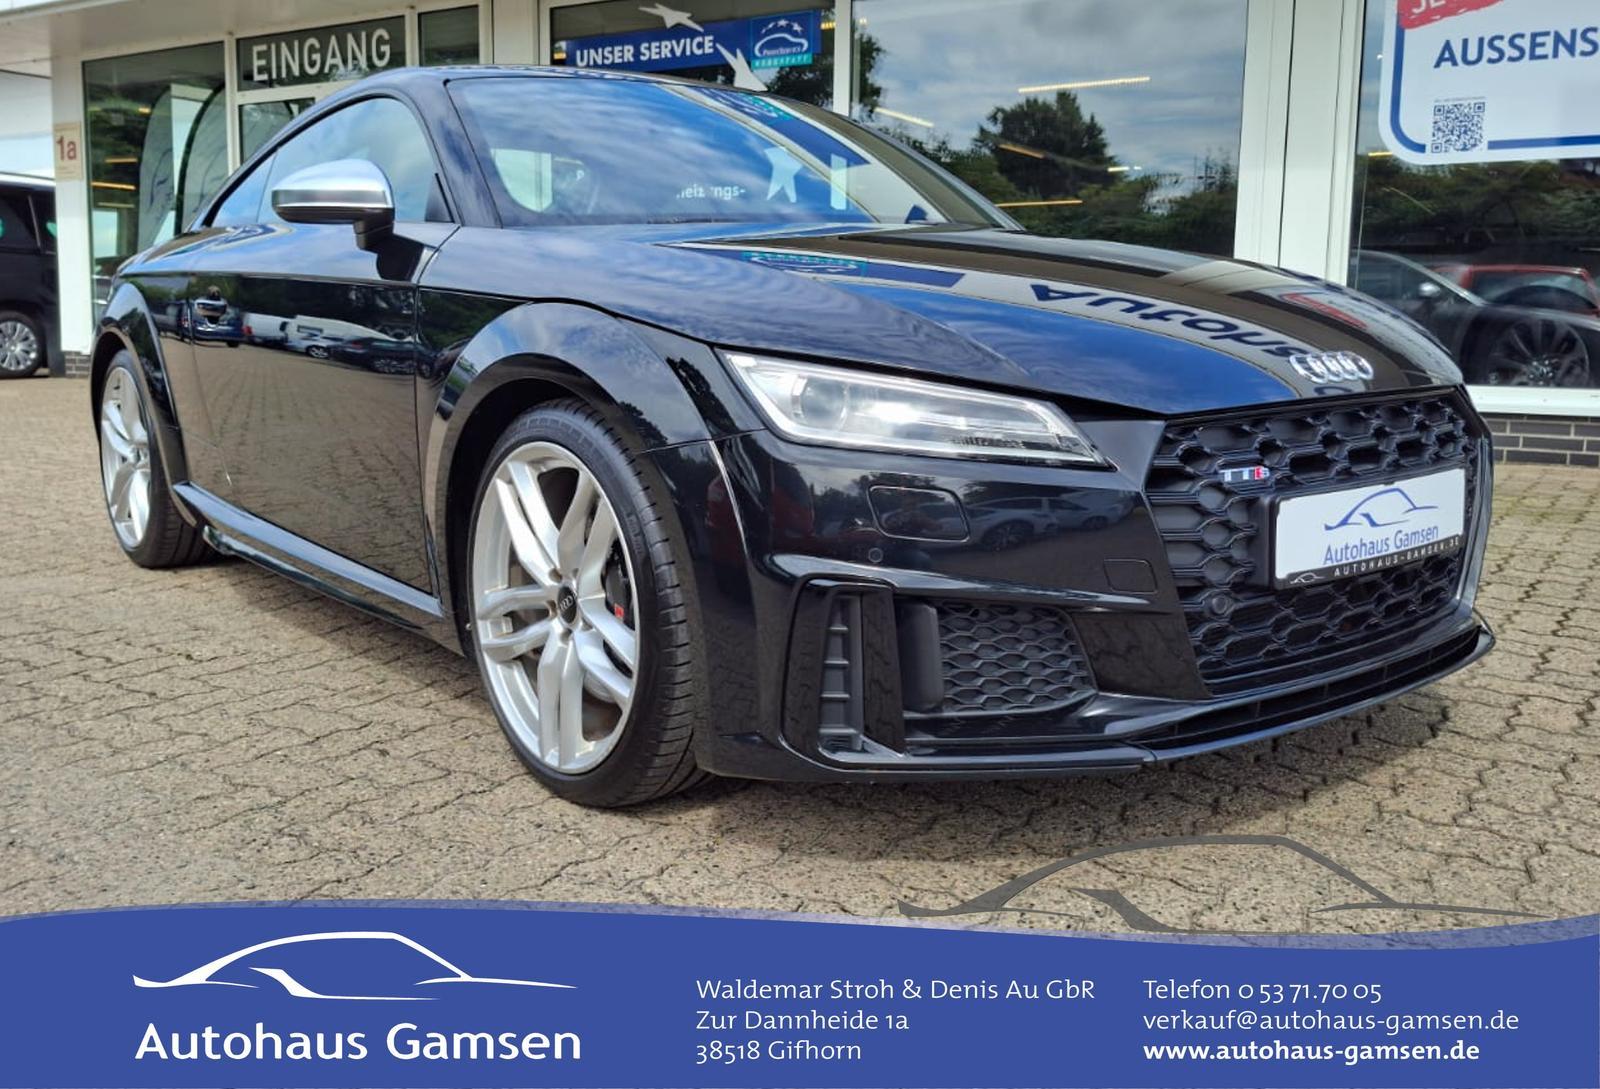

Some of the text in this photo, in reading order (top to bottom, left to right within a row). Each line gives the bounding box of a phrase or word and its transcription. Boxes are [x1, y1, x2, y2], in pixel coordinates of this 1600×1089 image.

[252, 28, 392, 82] EINGANG
[576, 35, 714, 68] UNSER SERVICE
[1433, 27, 1599, 69] AUSSENS
[55, 135, 77, 162] 1a
[1323, 525, 1439, 566] Autohaus Gamsen
